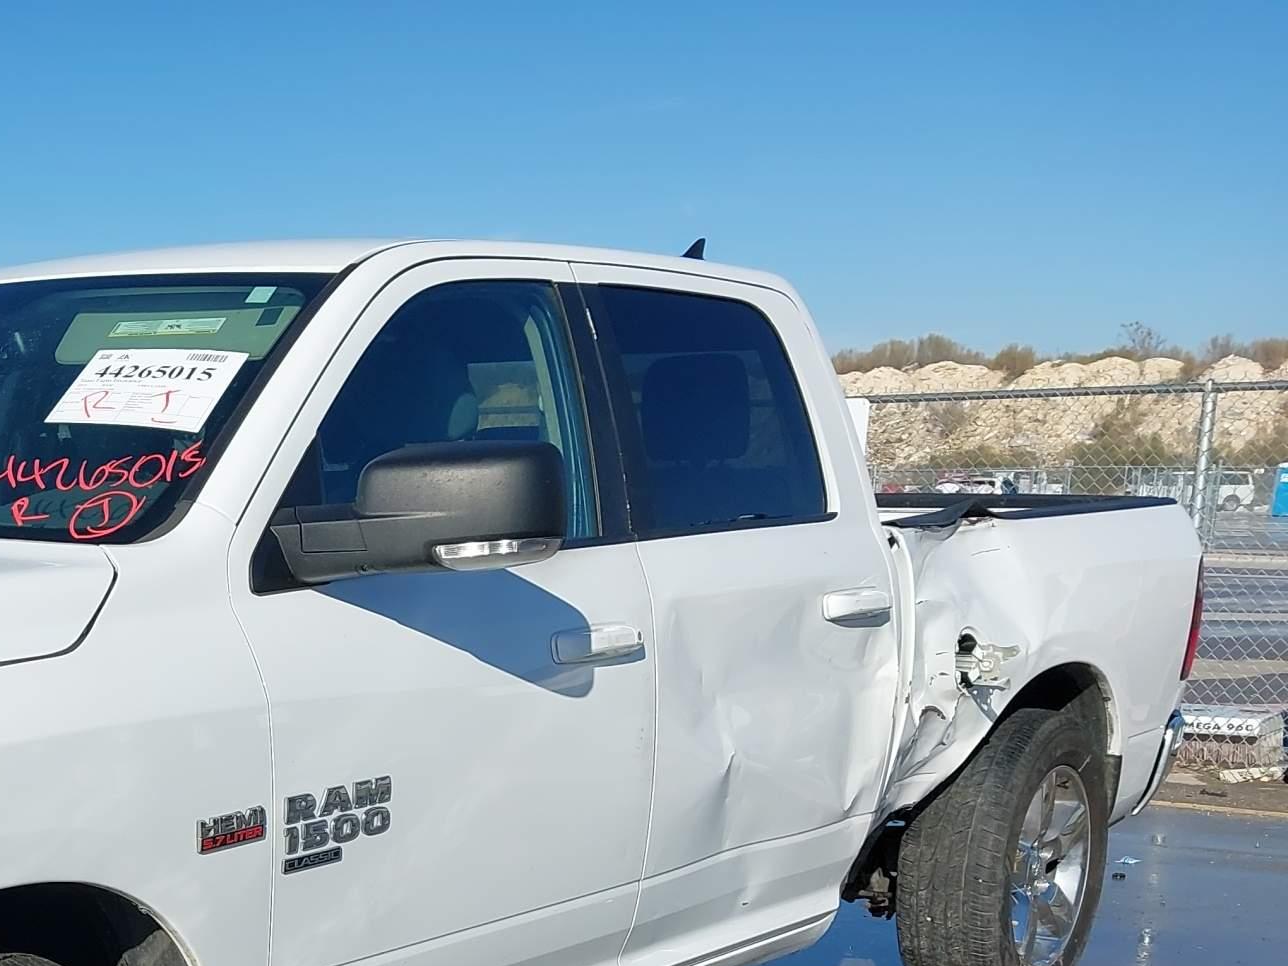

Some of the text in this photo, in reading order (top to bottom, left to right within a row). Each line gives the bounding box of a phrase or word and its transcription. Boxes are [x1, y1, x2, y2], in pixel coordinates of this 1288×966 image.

[95, 365, 216, 381] 44265015
[11, 496, 50, 527] R
[283, 775, 393, 825] RAM
[196, 805, 267, 839] HEMI
[283, 806, 392, 856] 1500
[202, 827, 263, 850] 5.7 LITER
[285, 848, 342, 871] CLASSIC
